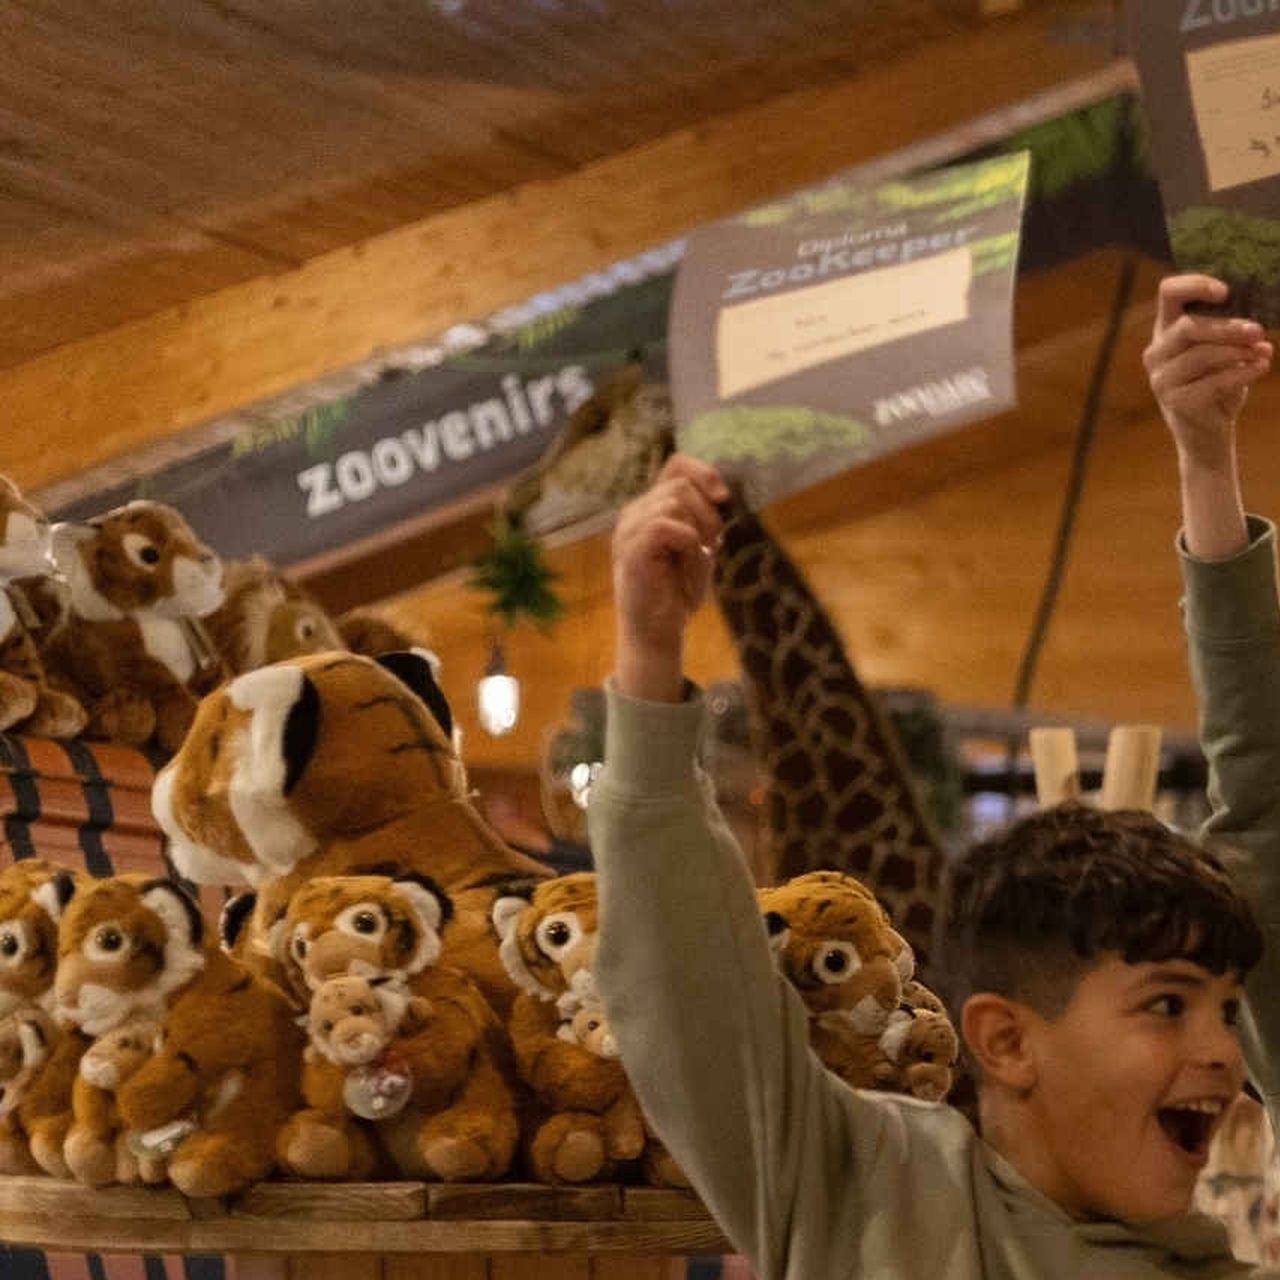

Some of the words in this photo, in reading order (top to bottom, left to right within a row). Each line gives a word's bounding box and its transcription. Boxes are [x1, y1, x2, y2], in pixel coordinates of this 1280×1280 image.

[722, 226, 979, 300] ZooKeeper
[797, 222, 908, 258] Diploma
[297, 364, 595, 519] zoovenirs
